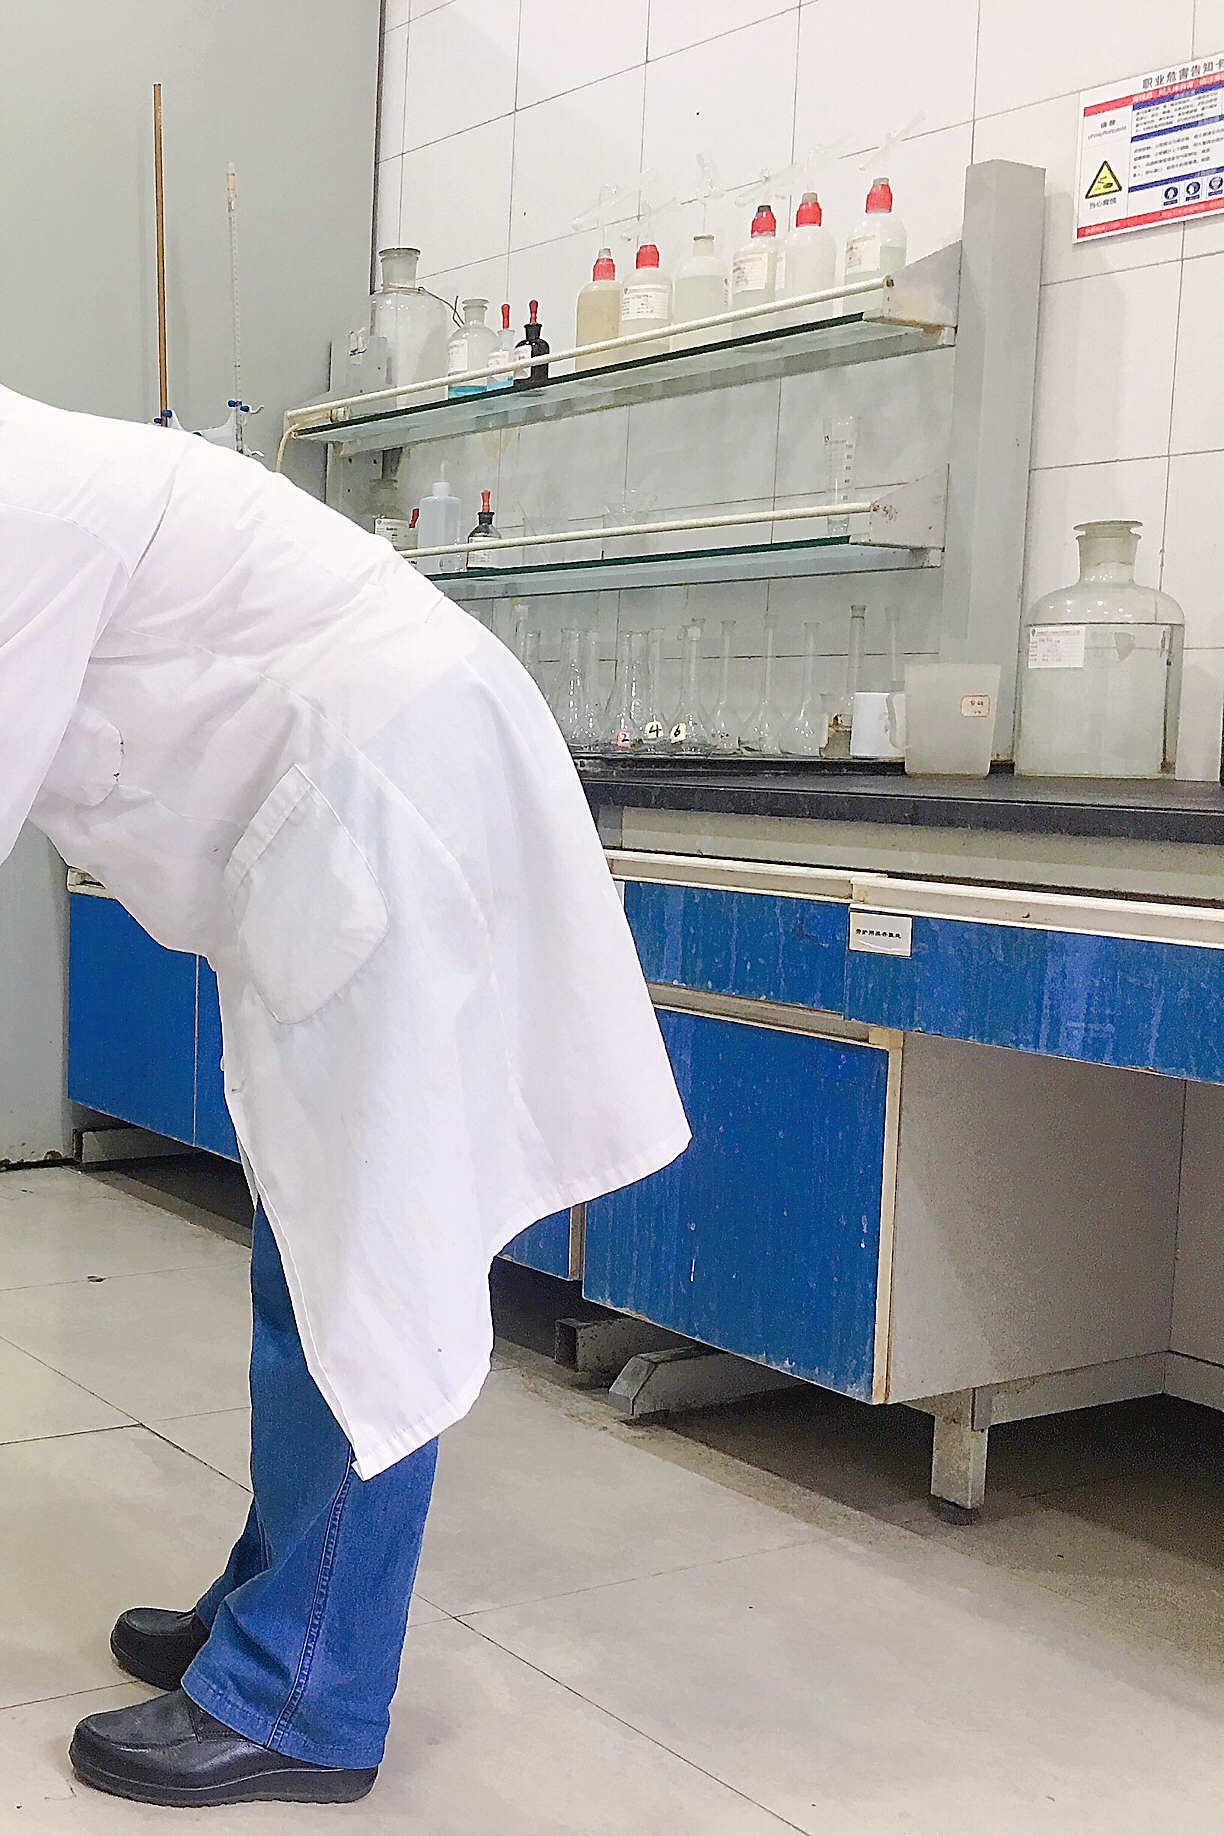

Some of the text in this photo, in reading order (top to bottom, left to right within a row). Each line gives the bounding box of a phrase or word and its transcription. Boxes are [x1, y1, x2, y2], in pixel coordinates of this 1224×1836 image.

[621, 733, 630, 743] 2
[648, 724, 662, 738] 4
[673, 724, 681, 738] 6
